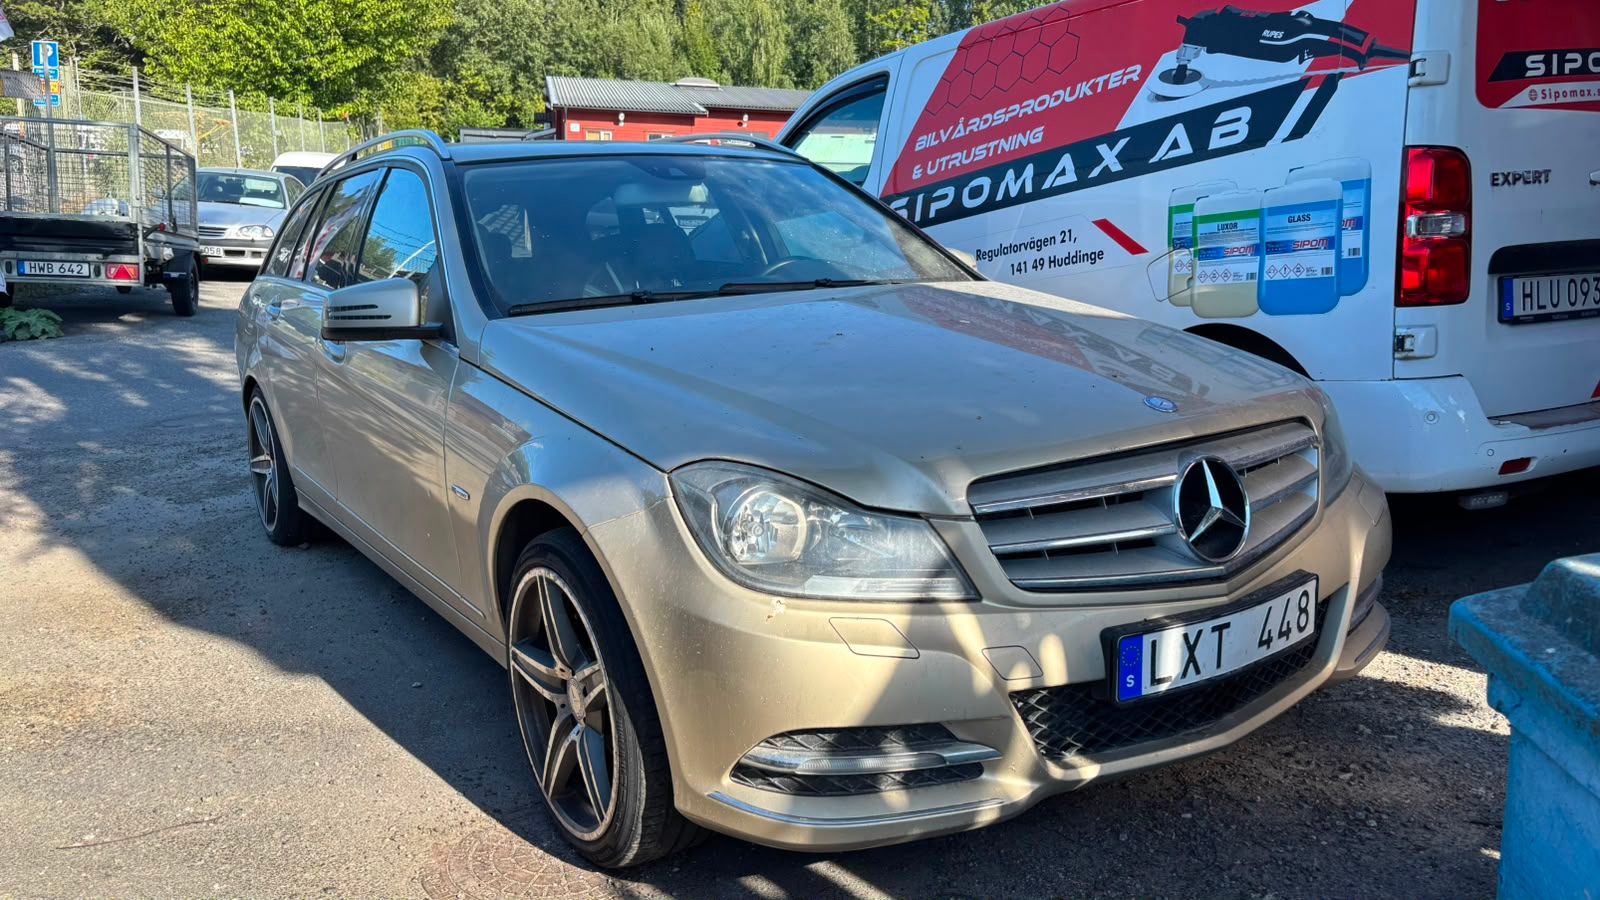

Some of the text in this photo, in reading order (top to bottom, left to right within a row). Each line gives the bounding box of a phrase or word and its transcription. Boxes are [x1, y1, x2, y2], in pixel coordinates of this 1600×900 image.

[1261, 29, 1285, 39] RUPES
[914, 64, 1143, 152] BILVÅRDSPRODUKTER
[889, 105, 1253, 223] SIPOMAX AB
[911, 125, 1046, 181] & UTRUSTNING
[1490, 168, 1552, 187] EXPERT
[1216, 221, 1239, 232] LUXOR
[1287, 213, 1312, 224] GLASS
[975, 228, 1078, 263] Regulatorvägen 21,
[28, 262, 84, 275] HWB 642
[1010, 249, 1105, 276] 141 49 Huddinge
[1522, 277, 1600, 312] HLU 093
[1505, 302, 1512, 311] S
[1150, 589, 1310, 687] LXT 448
[1125, 674, 1135, 689] S
